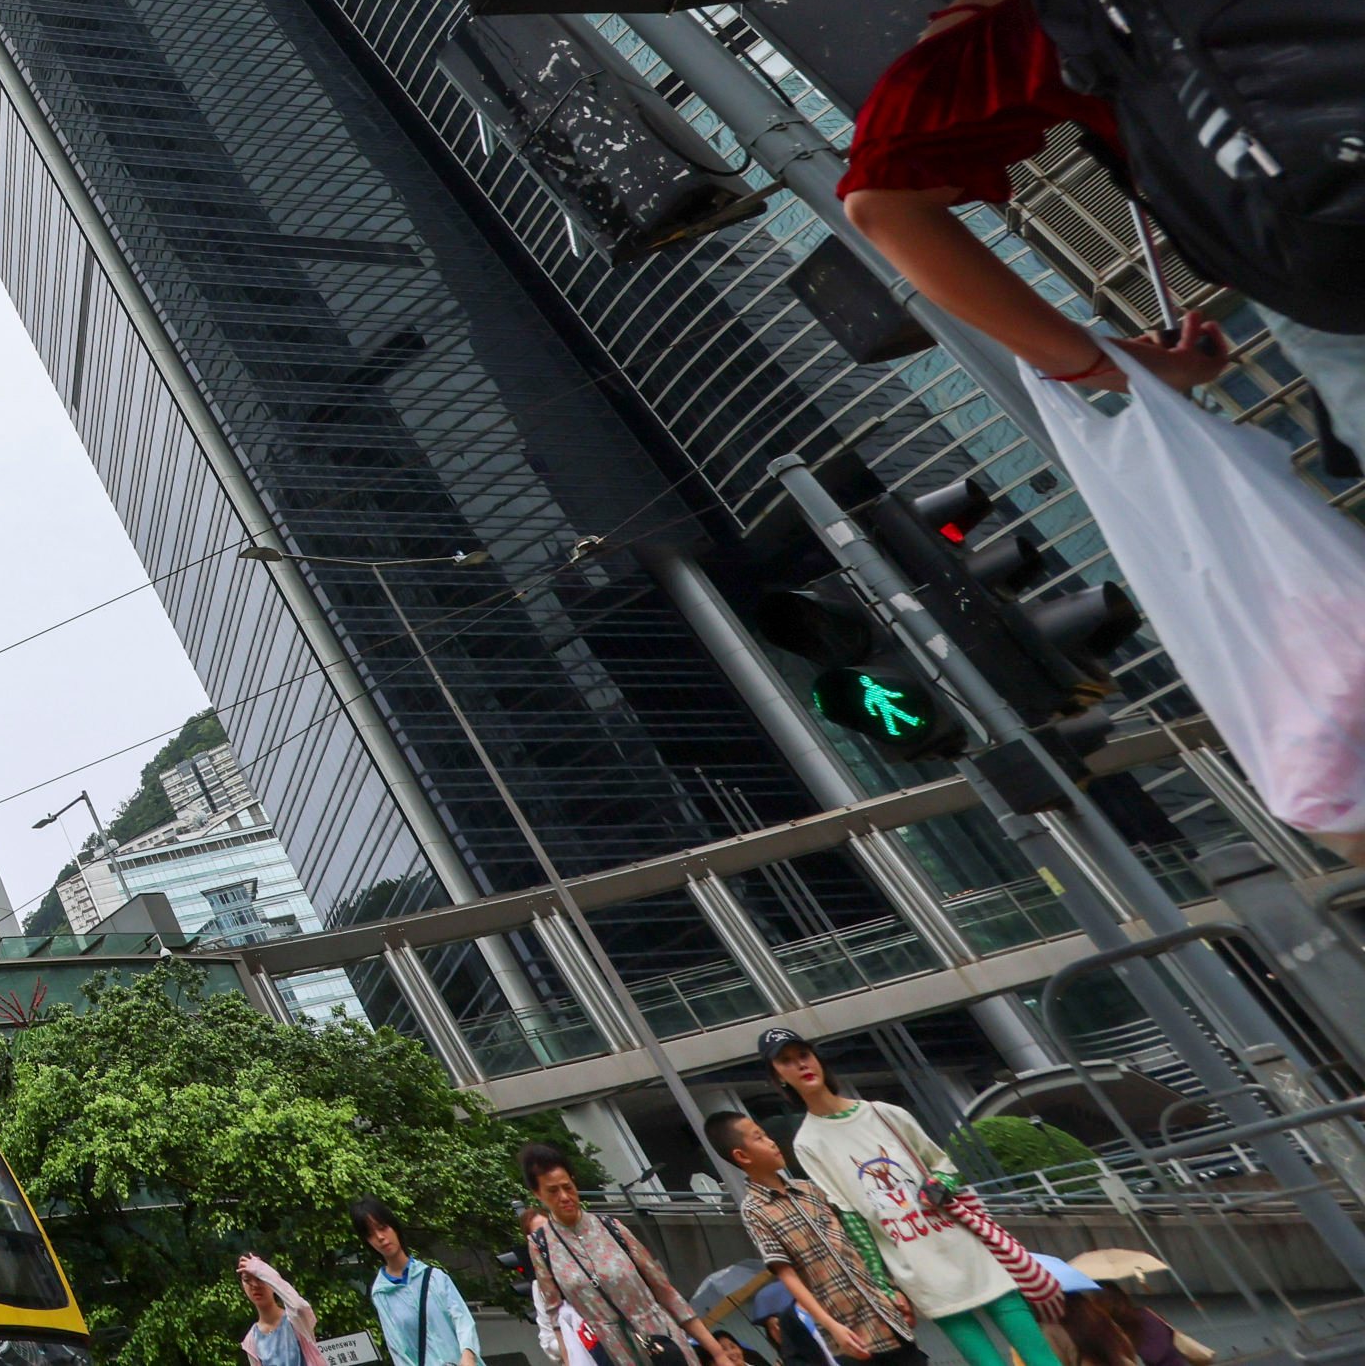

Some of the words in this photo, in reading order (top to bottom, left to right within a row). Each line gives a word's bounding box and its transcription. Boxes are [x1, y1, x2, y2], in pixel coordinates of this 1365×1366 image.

[318, 1340, 357, 1353] Queensway
[327, 1350, 359, 1366] 金鐘道
